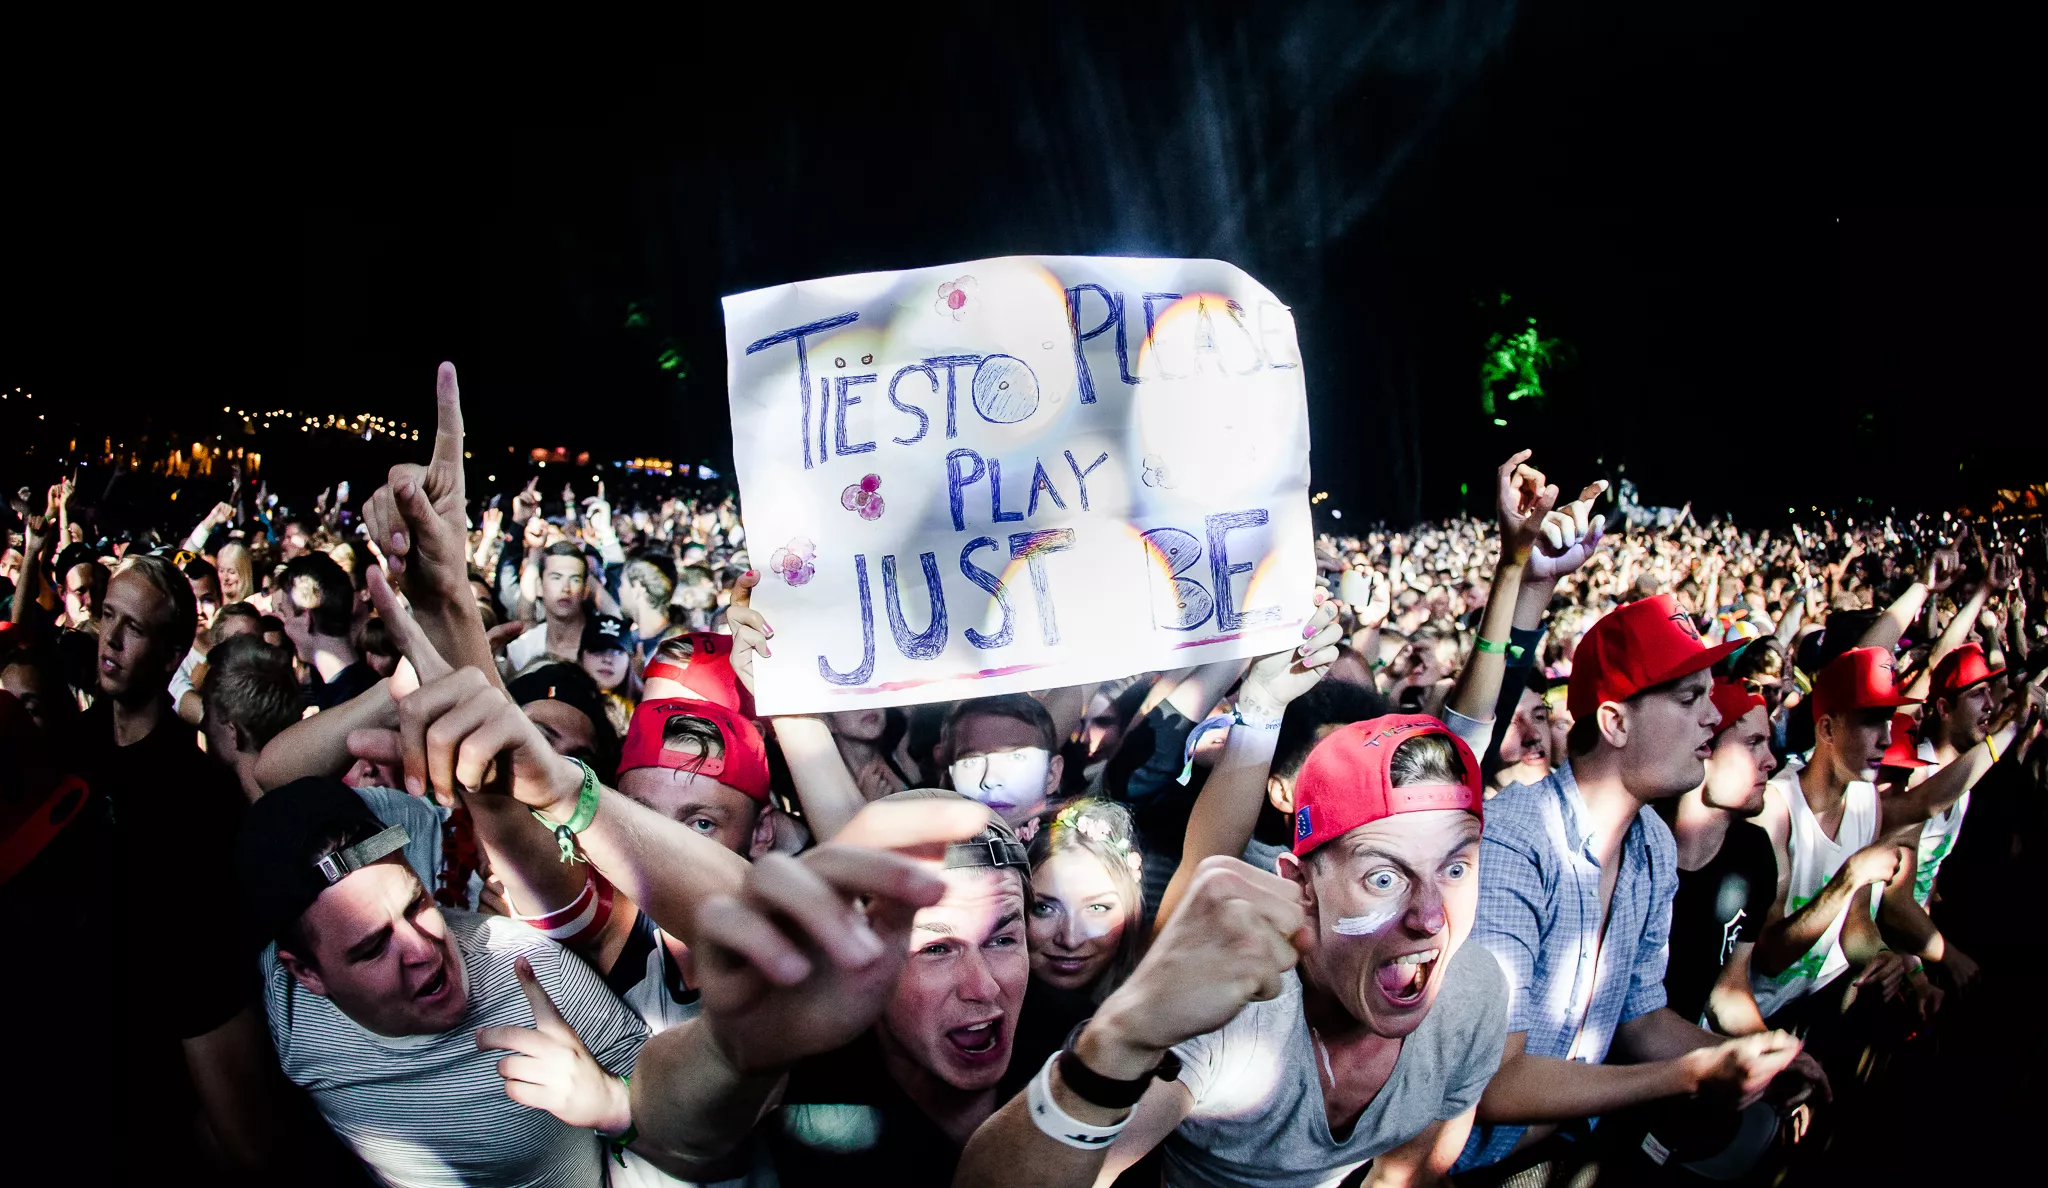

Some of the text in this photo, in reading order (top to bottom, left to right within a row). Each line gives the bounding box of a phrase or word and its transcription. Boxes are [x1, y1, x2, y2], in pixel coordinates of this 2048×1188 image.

[745, 283, 1298, 470] TIËSTO PLEASE
[945, 448, 1108, 531] PLAY
[818, 508, 1284, 686] JUST BE
